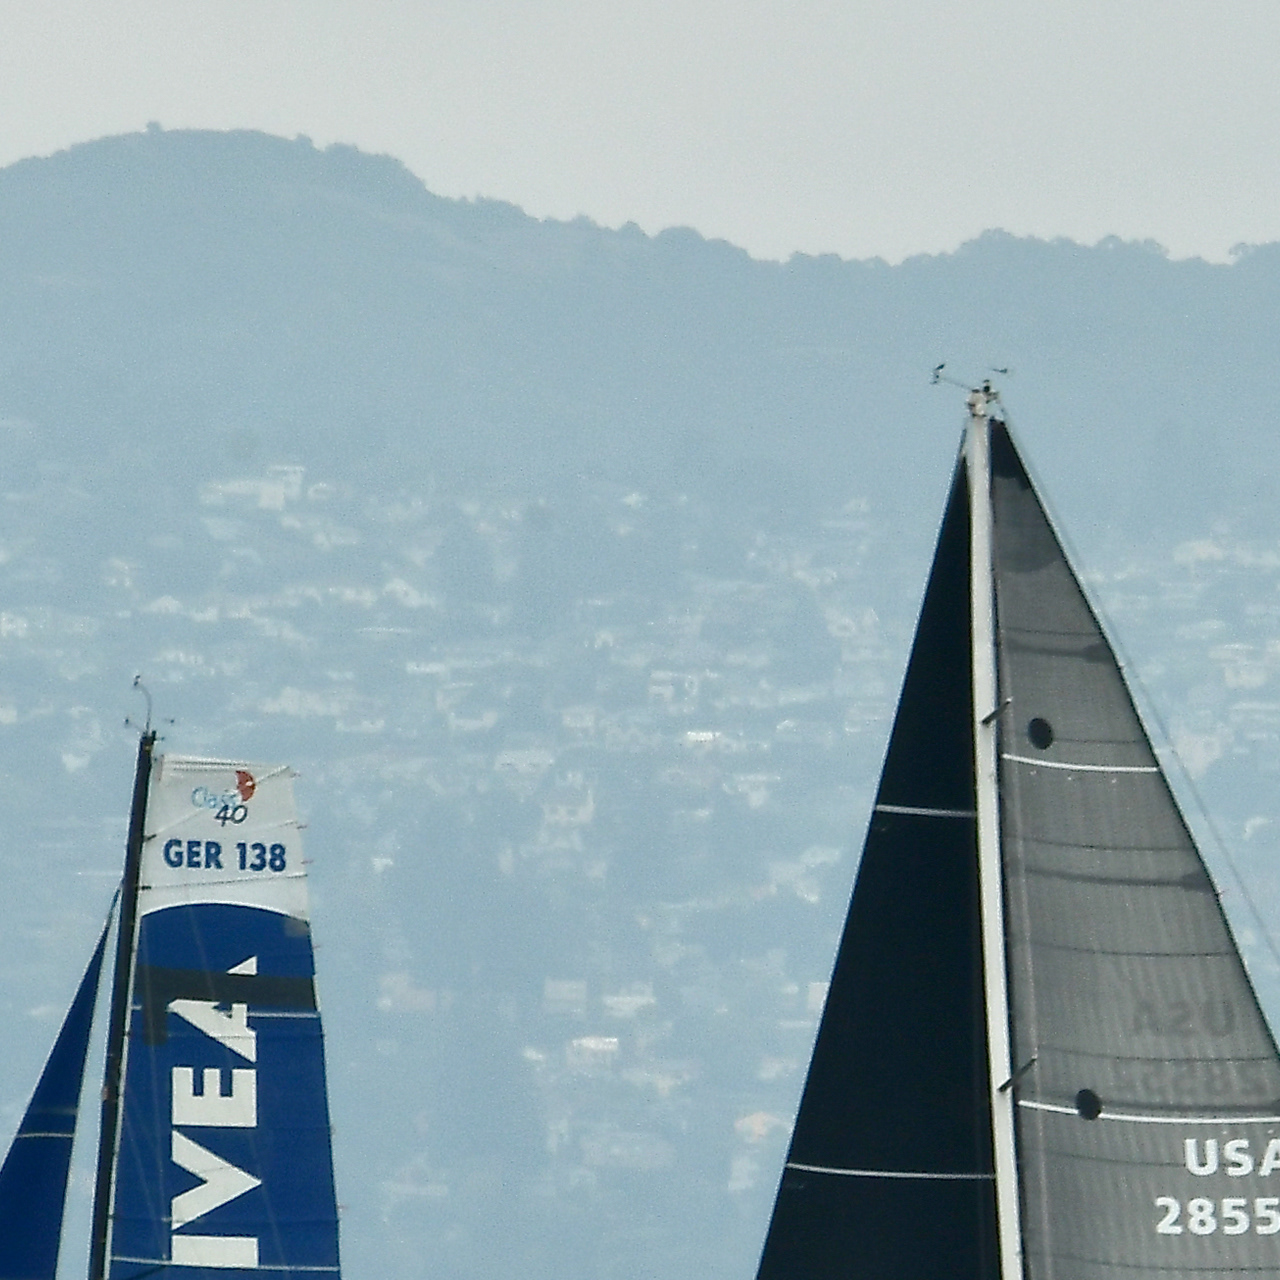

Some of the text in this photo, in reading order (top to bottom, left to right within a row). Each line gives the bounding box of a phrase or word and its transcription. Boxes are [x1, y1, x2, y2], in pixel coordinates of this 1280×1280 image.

[214, 804, 248, 828] 40
[163, 839, 287, 873] GER 138
